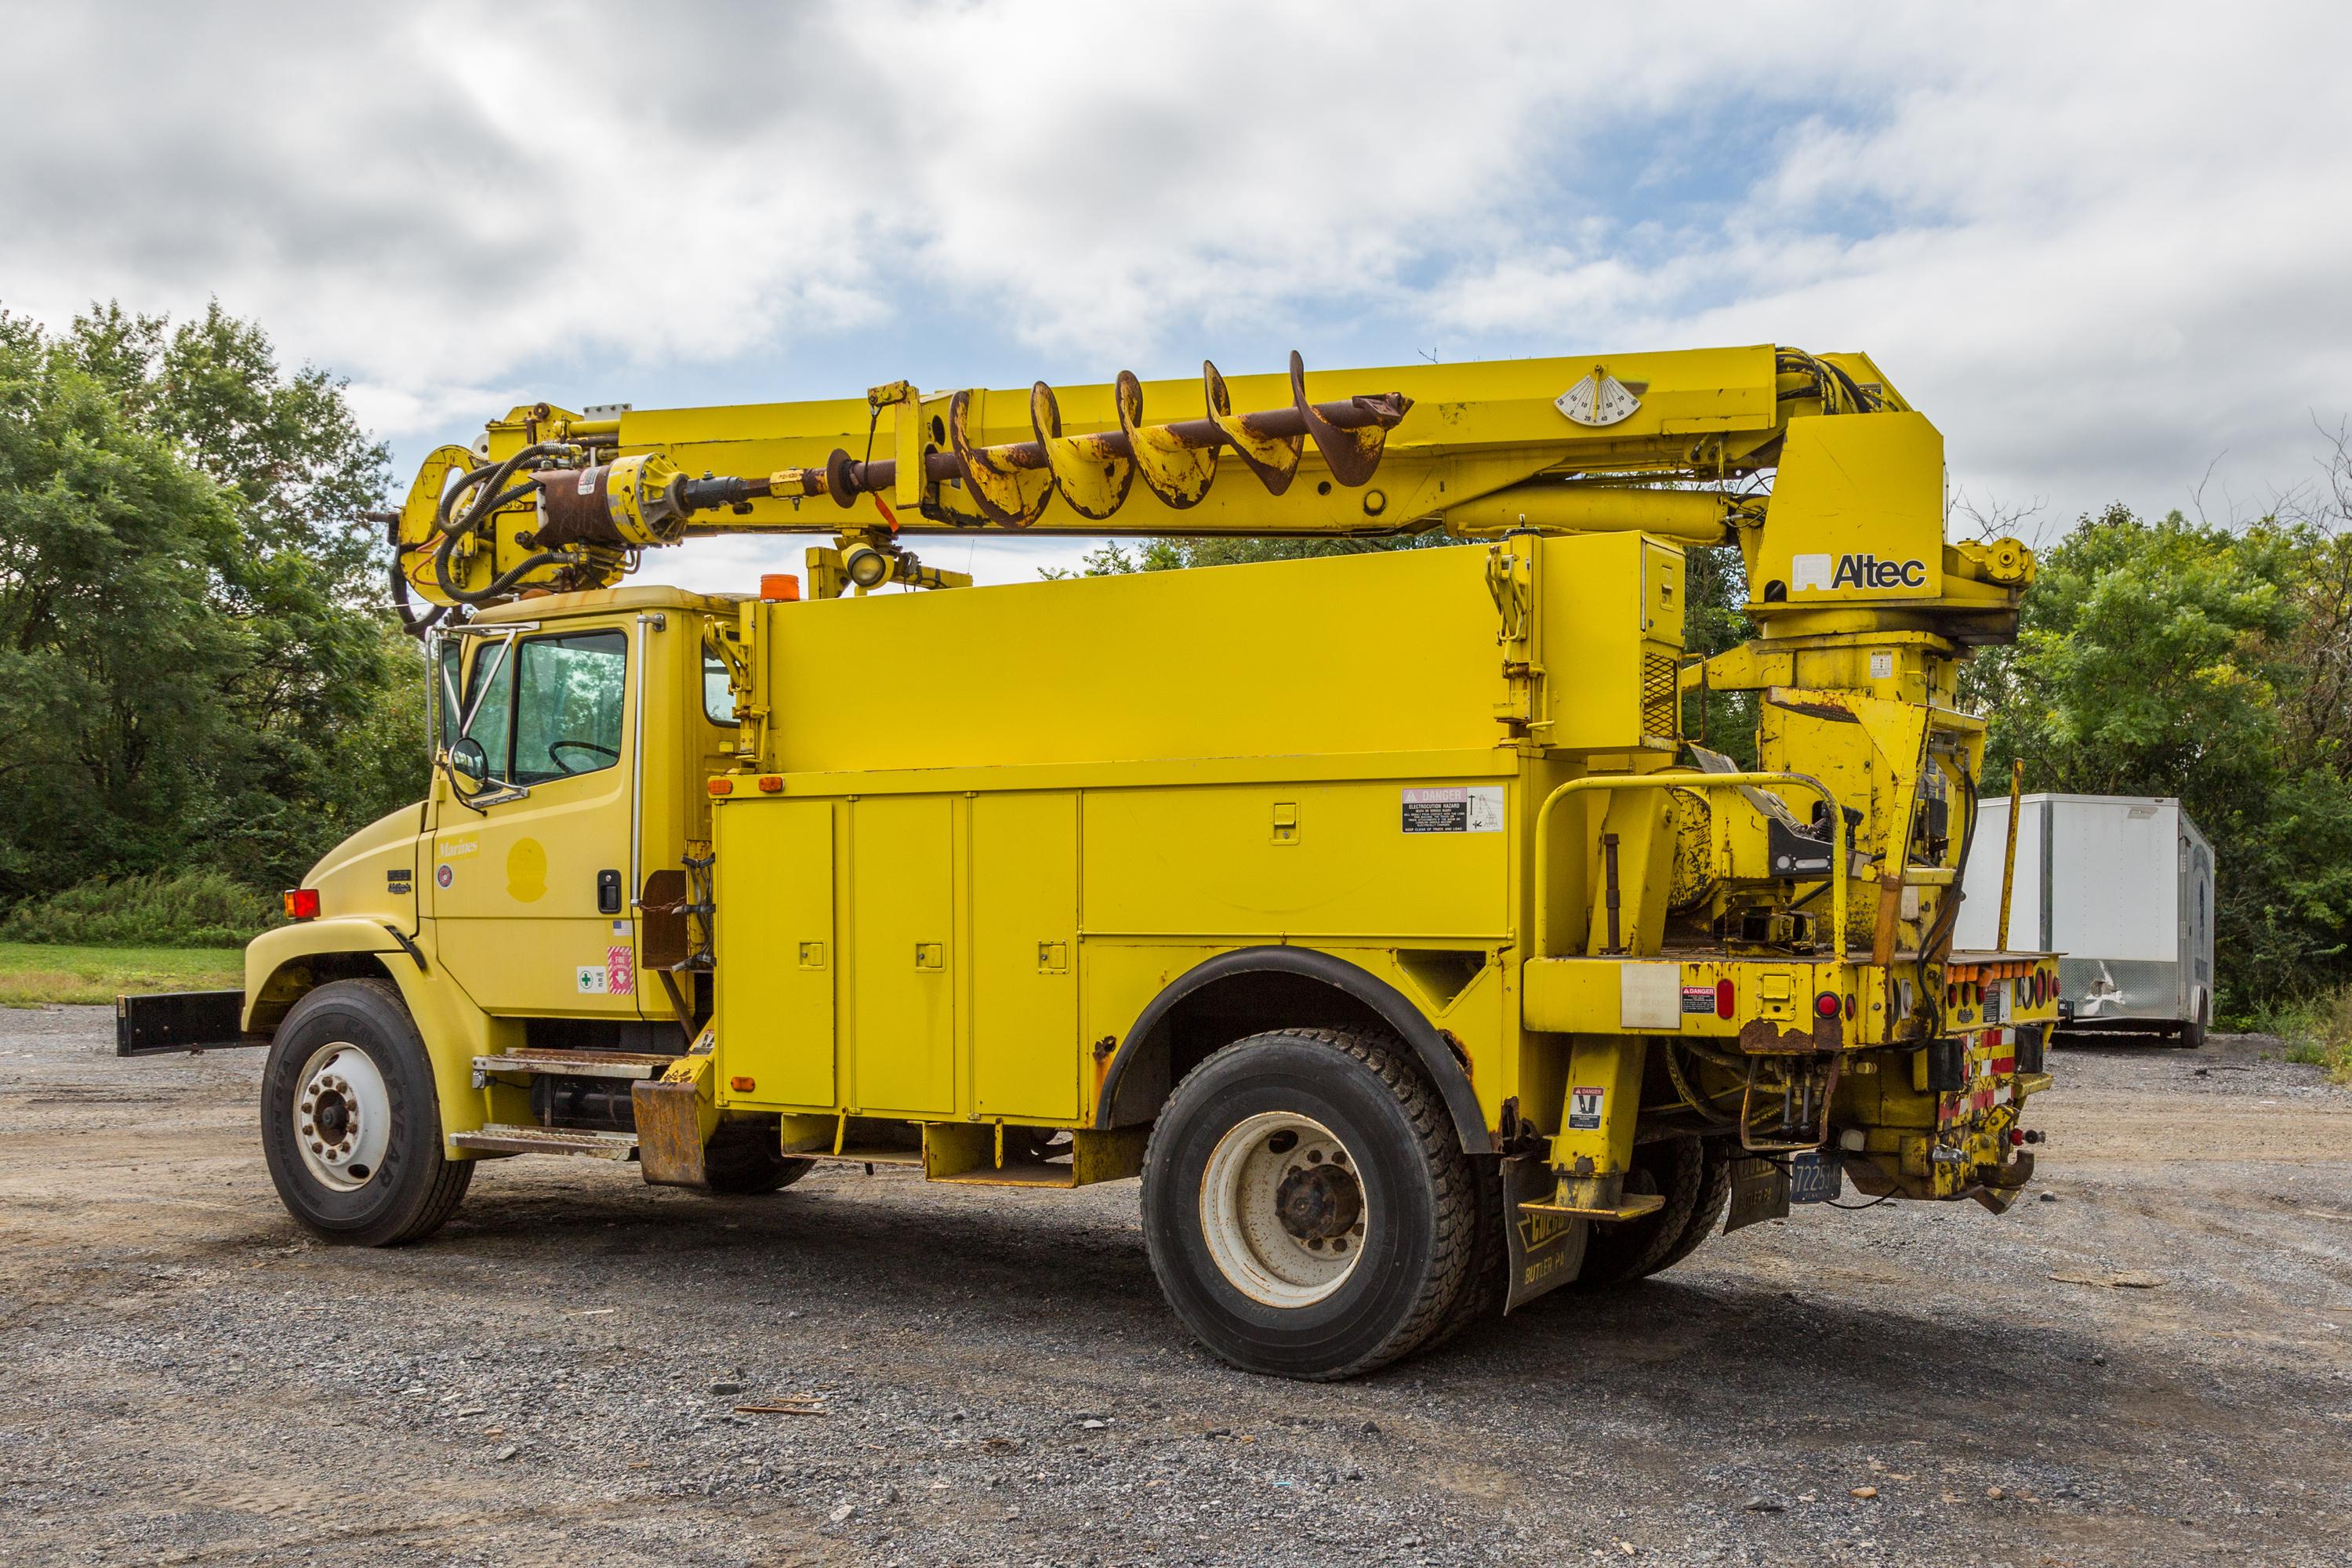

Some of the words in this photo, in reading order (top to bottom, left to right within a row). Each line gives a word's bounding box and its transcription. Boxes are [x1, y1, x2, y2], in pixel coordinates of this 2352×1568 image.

[1831, 554, 1926, 588] Altec
[1422, 789, 1461, 801] DANGER
[438, 838, 477, 858] Marines
[1525, 1256, 1552, 1285] BUTLER
